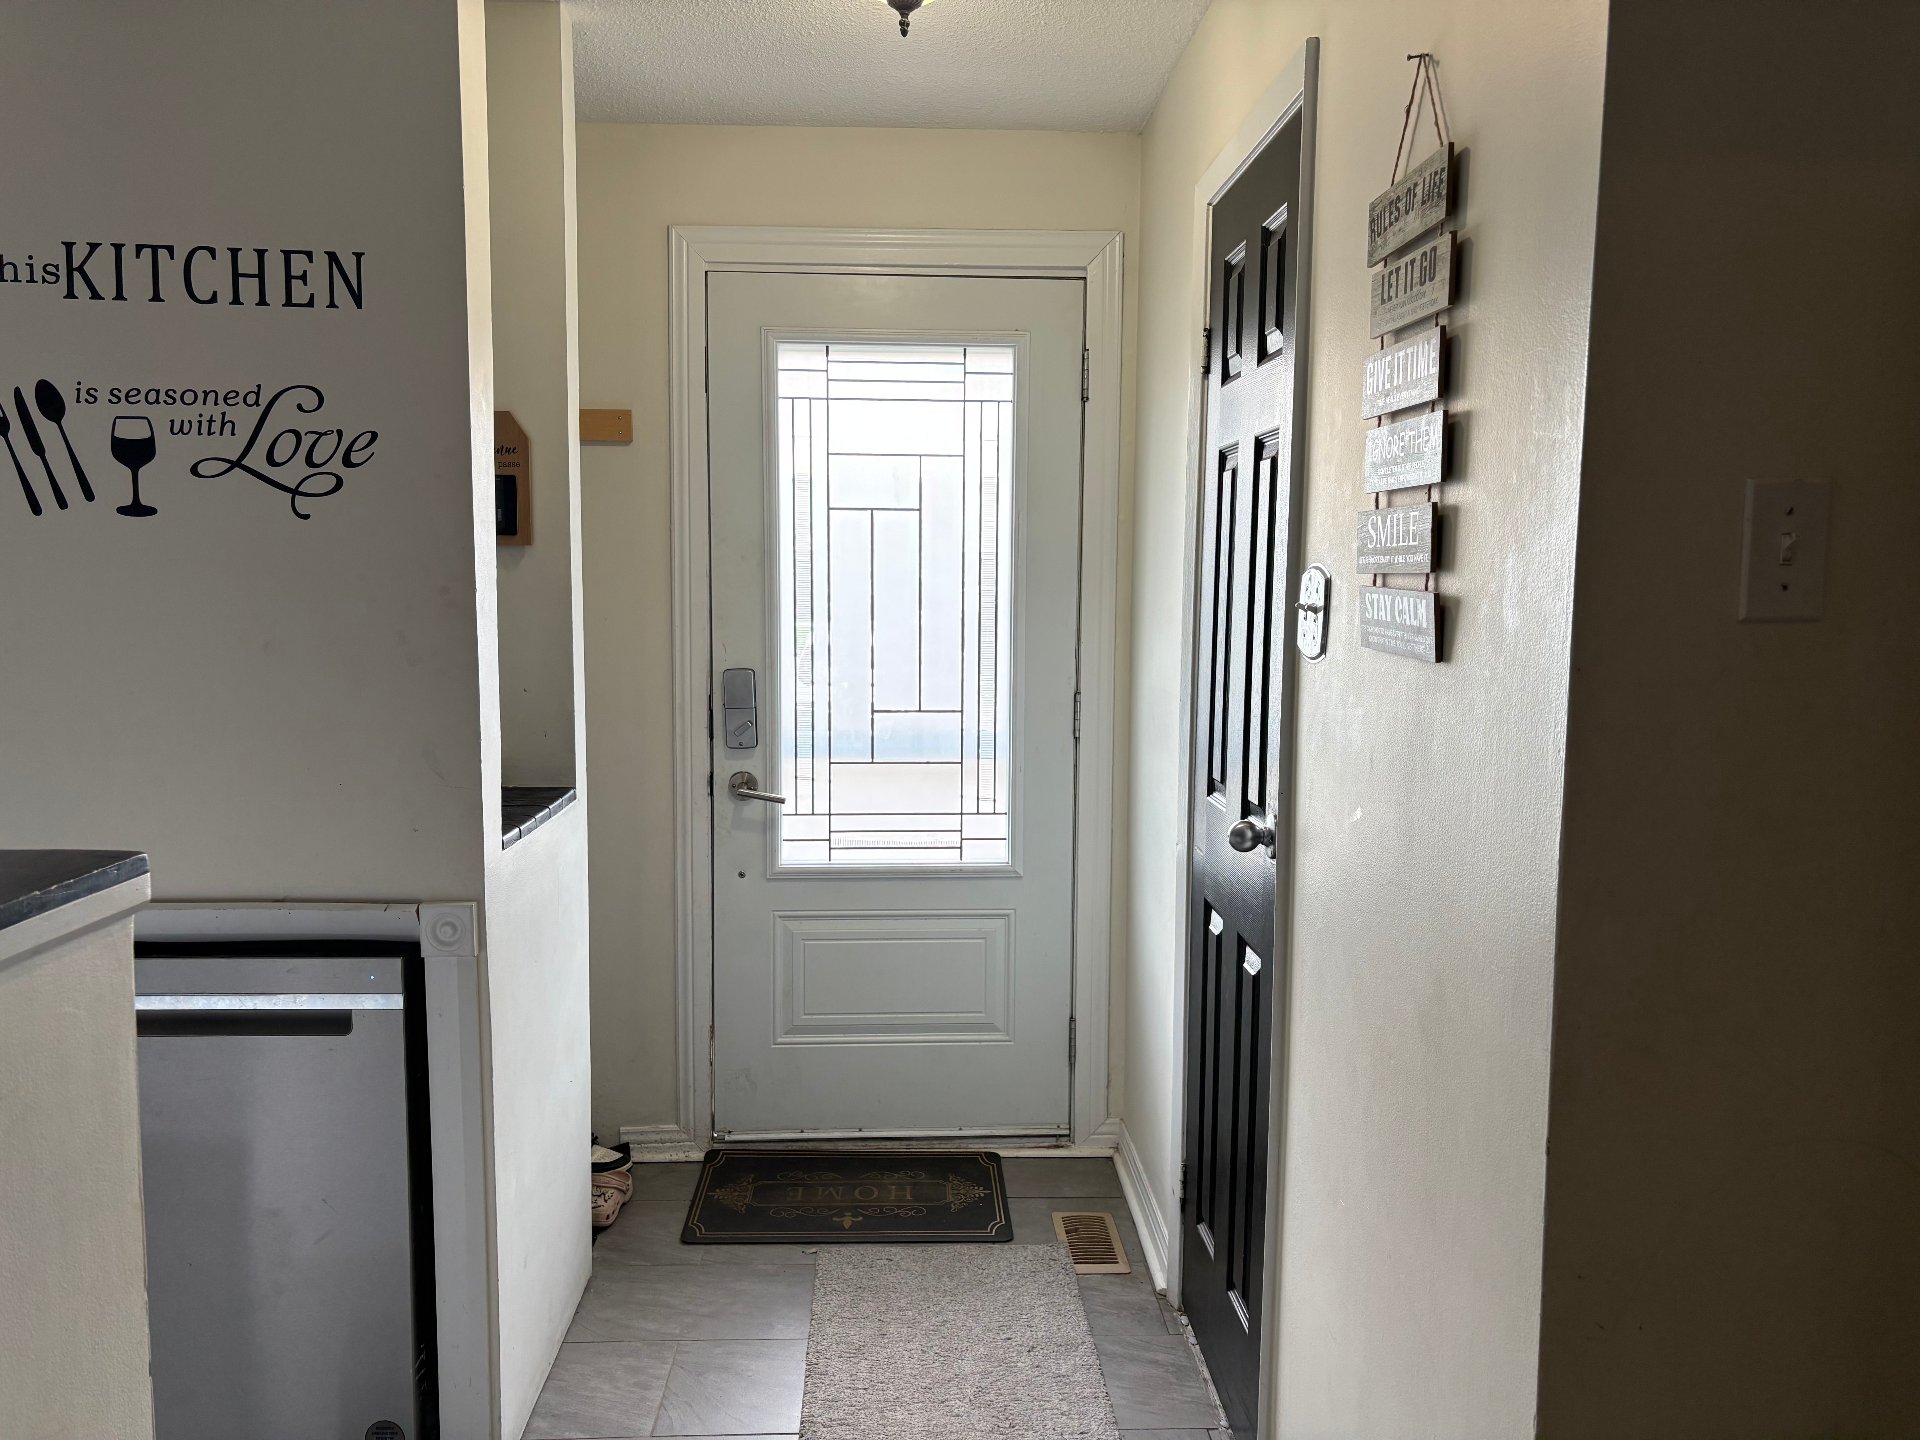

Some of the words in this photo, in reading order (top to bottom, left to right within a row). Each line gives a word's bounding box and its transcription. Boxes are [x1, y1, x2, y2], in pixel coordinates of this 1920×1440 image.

[1369, 195, 1401, 245] RULES
[1404, 182, 1417, 216] OF
[1420, 167, 1446, 207] LIFE
[60, 241, 366, 310] KITCHEN
[1380, 266, 1402, 306] LET
[1403, 257, 1417, 295] IT
[1419, 245, 1438, 287] GO
[1366, 355, 1392, 396] GIVE
[1393, 349, 1406, 387] IT
[1406, 338, 1437, 382] TIME
[75, 381, 99, 404] is
[107, 383, 262, 408] seasoned
[168, 412, 237, 437] with
[190, 384, 379, 520] Love
[1367, 511, 1420, 549] SMILE
[1365, 592, 1393, 622] STAY
[1394, 595, 1428, 628] CALM
[785, 1185, 914, 1201] HOME
